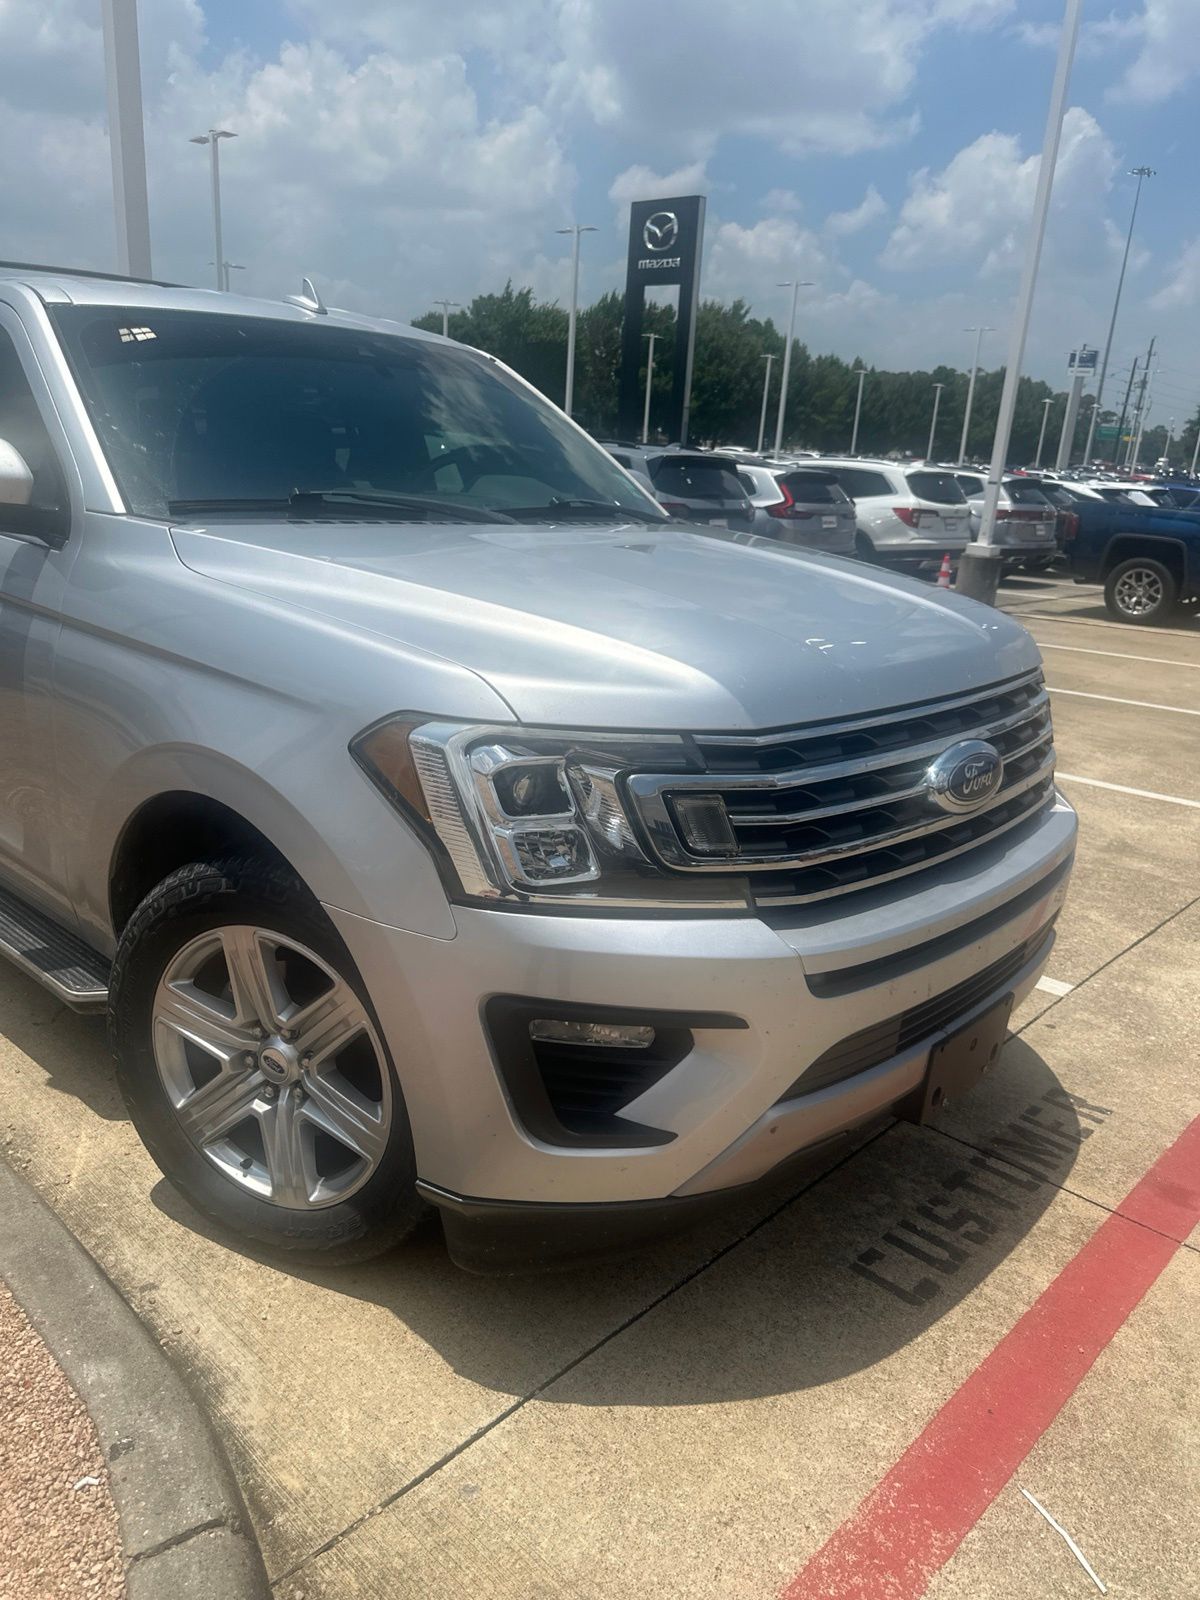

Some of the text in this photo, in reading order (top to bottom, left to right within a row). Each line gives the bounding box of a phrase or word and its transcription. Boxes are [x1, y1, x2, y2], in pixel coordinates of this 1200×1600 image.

[638, 257, 681, 269] mazda
[963, 760, 994, 794] Ford
[848, 1087, 1114, 1307] CUSTOMER
